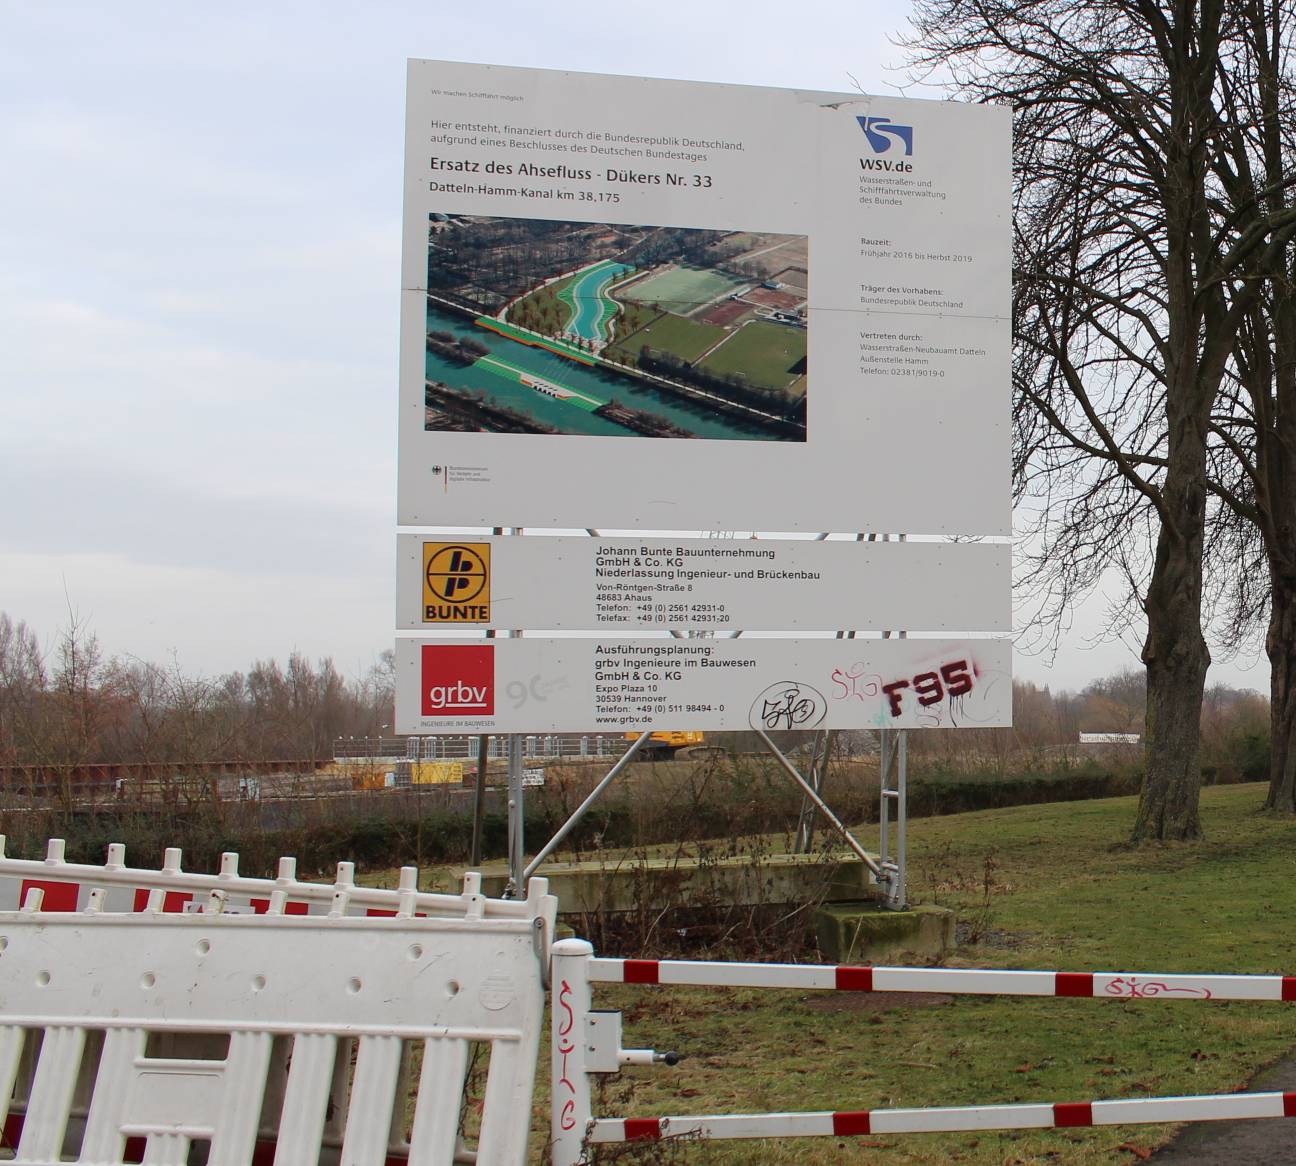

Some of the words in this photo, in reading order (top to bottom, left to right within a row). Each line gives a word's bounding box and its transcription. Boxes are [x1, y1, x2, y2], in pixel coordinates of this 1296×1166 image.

[431, 120, 453, 130] Hier
[455, 122, 501, 134] entsteht,
[504, 125, 551, 137] finanziert
[555, 129, 583, 139] durch
[586, 132, 602, 140] die
[604, 133, 679, 146] Bundesrepublik
[682, 138, 745, 151] Deutschland,
[430, 134, 477, 145] aufgrund
[480, 138, 506, 147] eines
[509, 140, 567, 152] Beschlusses
[570, 144, 588, 153] des
[590, 145, 642, 157] Deutschen
[646, 149, 708, 162] Bundestages
[859, 158, 913, 173] WSV.de
[430, 157, 480, 173] Ersatz
[485, 160, 513, 175] des
[518, 163, 592, 180] Ahsefluss
[606, 168, 661, 185] Dükers
[666, 173, 688, 187] Nr.
[692, 174, 713, 188] 33
[859, 176, 916, 186] Wasserstraßen-
[917, 180, 932, 188] und
[429, 181, 553, 199] Datteln-Hamm-Kanal
[557, 190, 575, 200] km
[578, 191, 621, 203] 38,175
[859, 186, 946, 200] Schifffahrtsverwaltung
[859, 196, 872, 204] des
[875, 197, 903, 206] Bundes
[861, 237, 892, 246] Bauzeit:
[861, 249, 891, 258] Frühjahr
[927, 253, 951, 262] Herbst
[952, 255, 973, 263] 2019
[861, 284, 885, 294] Träger
[902, 287, 944, 296] Vorhabens:
[861, 296, 916, 306] Bundesrepublik
[918, 300, 964, 308] Deutschland
[860, 332, 897, 340] Vertreten
[898, 334, 923, 342] durch:
[959, 348, 986, 356] Datteln
[860, 355, 903, 364] Außenstelle
[905, 357, 929, 365] Hamm
[860, 367, 889, 376] Telefon:
[596, 547, 637, 556] Johann
[641, 547, 672, 556] Bunte
[676, 547, 775, 559] Bauunternehmung
[596, 558, 630, 566] GmbH
[634, 558, 641, 566] &
[645, 558, 663, 567] Co.
[667, 558, 683, 567] KG
[596, 568, 674, 580] Niederlassung
[677, 569, 731, 580] Ingenieur-
[734, 570, 754, 579] und
[757, 569, 820, 580] Brückenbau
[596, 583, 685, 593] Von-Röntgen-Straße
[426, 605, 488, 619] BUNTE
[596, 604, 631, 612] Telefon:
[636, 604, 652, 612] +49
[655, 604, 667, 613] (0)
[668, 604, 688, 612] 2561
[691, 604, 725, 612] 42931-0
[596, 614, 631, 622] Telefax:
[636, 614, 652, 622] +49
[655, 614, 667, 623] (0)
[668, 614, 689, 622] 2561
[691, 614, 730, 622] 42931-20
[595, 644, 714, 656] Ausführungsplanung:
[595, 659, 620, 669] grbv
[623, 658, 681, 669] Ingenieure
[684, 658, 698, 667] im
[700, 658, 756, 668] Bauwesen
[595, 672, 629, 681] GmbH
[632, 672, 640, 680] &
[643, 672, 662, 681] Co.
[665, 672, 682, 680] KG
[430, 680, 487, 709] grbv
[596, 685, 619, 694] Expo
[882, 659, 975, 718] F95
[596, 705, 631, 713] Telefon:
[654, 705, 666, 713] (0)
[596, 716, 652, 725] www.grbv.de
